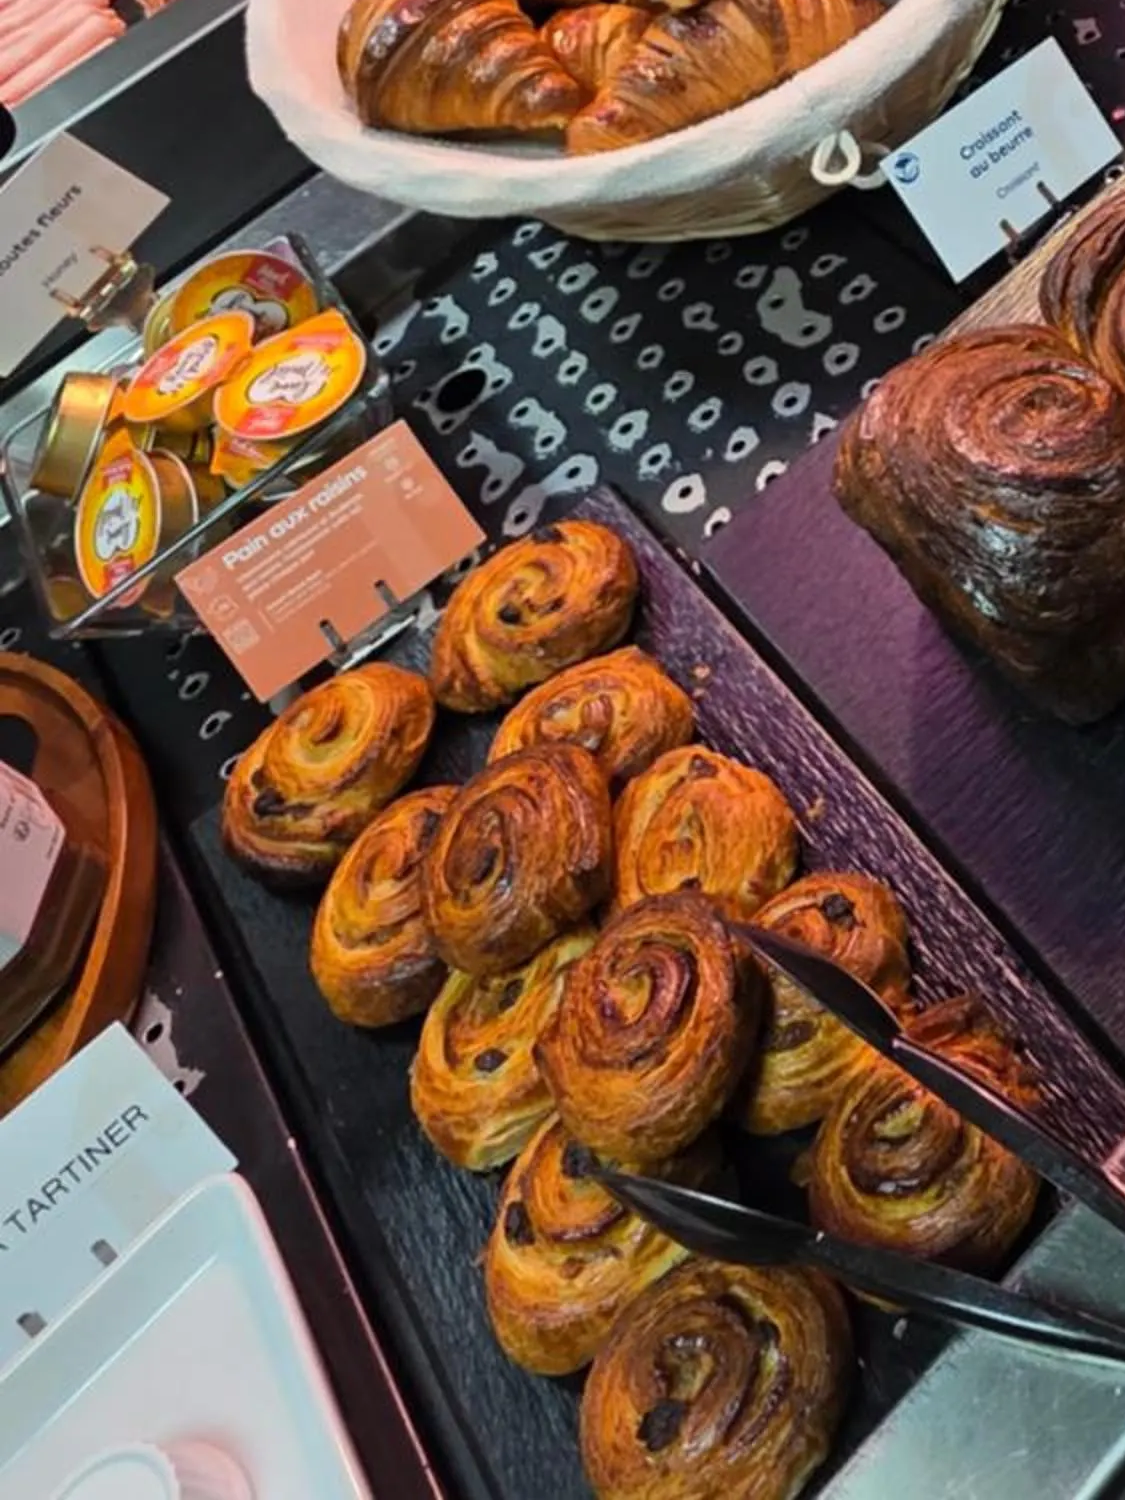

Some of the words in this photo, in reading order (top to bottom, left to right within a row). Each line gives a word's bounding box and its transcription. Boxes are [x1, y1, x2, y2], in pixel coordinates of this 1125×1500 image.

[959, 109, 1023, 160] Croissant
[969, 159, 990, 179] au
[988, 126, 1034, 163] beurre
[0, 228, 41, 276] outes
[37, 184, 82, 228] fleurs
[220, 532, 269, 570] Pain
[269, 506, 309, 539] aux
[308, 465, 368, 514] raisins
[3, 1104, 149, 1233] TARTINER
